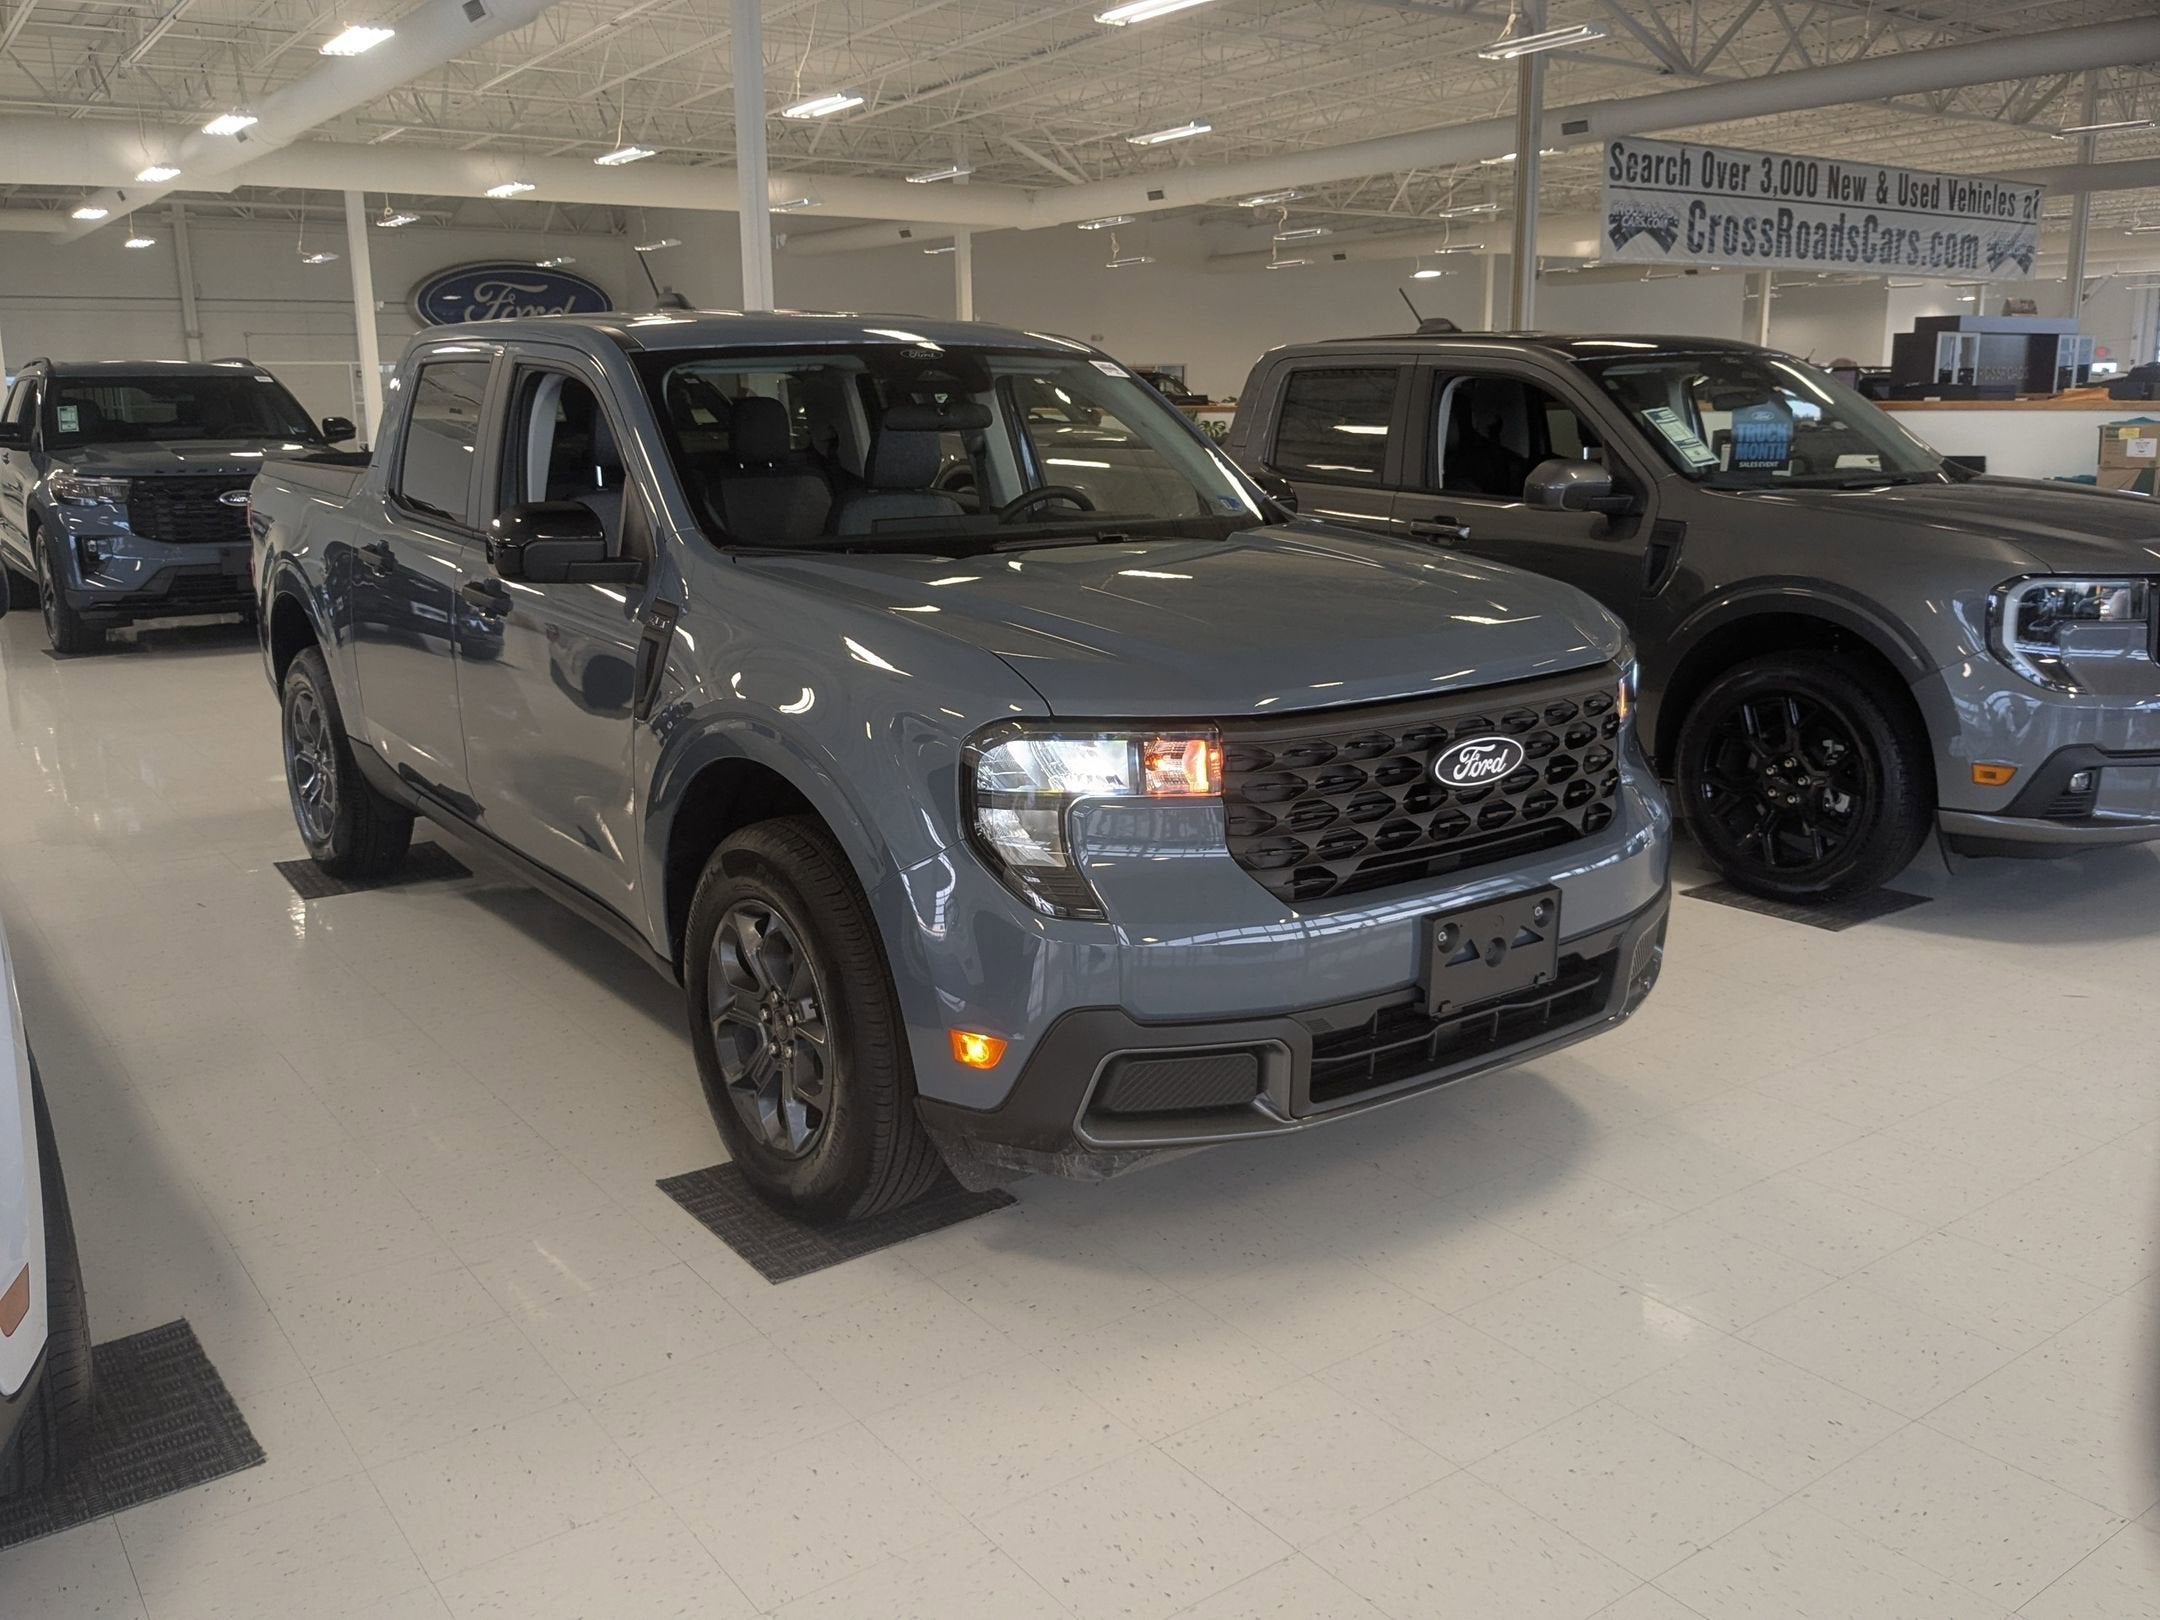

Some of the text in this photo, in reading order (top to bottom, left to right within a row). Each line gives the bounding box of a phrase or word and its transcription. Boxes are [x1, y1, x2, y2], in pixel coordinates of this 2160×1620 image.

[1609, 142, 1691, 187] Search
[1701, 151, 1750, 191] Over
[1760, 157, 1818, 198] 3,000
[1827, 165, 1867, 202] New
[1876, 171, 1889, 205] &
[1898, 173, 1940, 210] Used
[1948, 179, 2016, 218] Vehicles
[1687, 200, 1979, 270] CrossRoadsCars.com
[1736, 423, 1788, 441] TRUCK
[1735, 443, 1787, 459] MONTH
[1453, 744, 1509, 780] Ford
